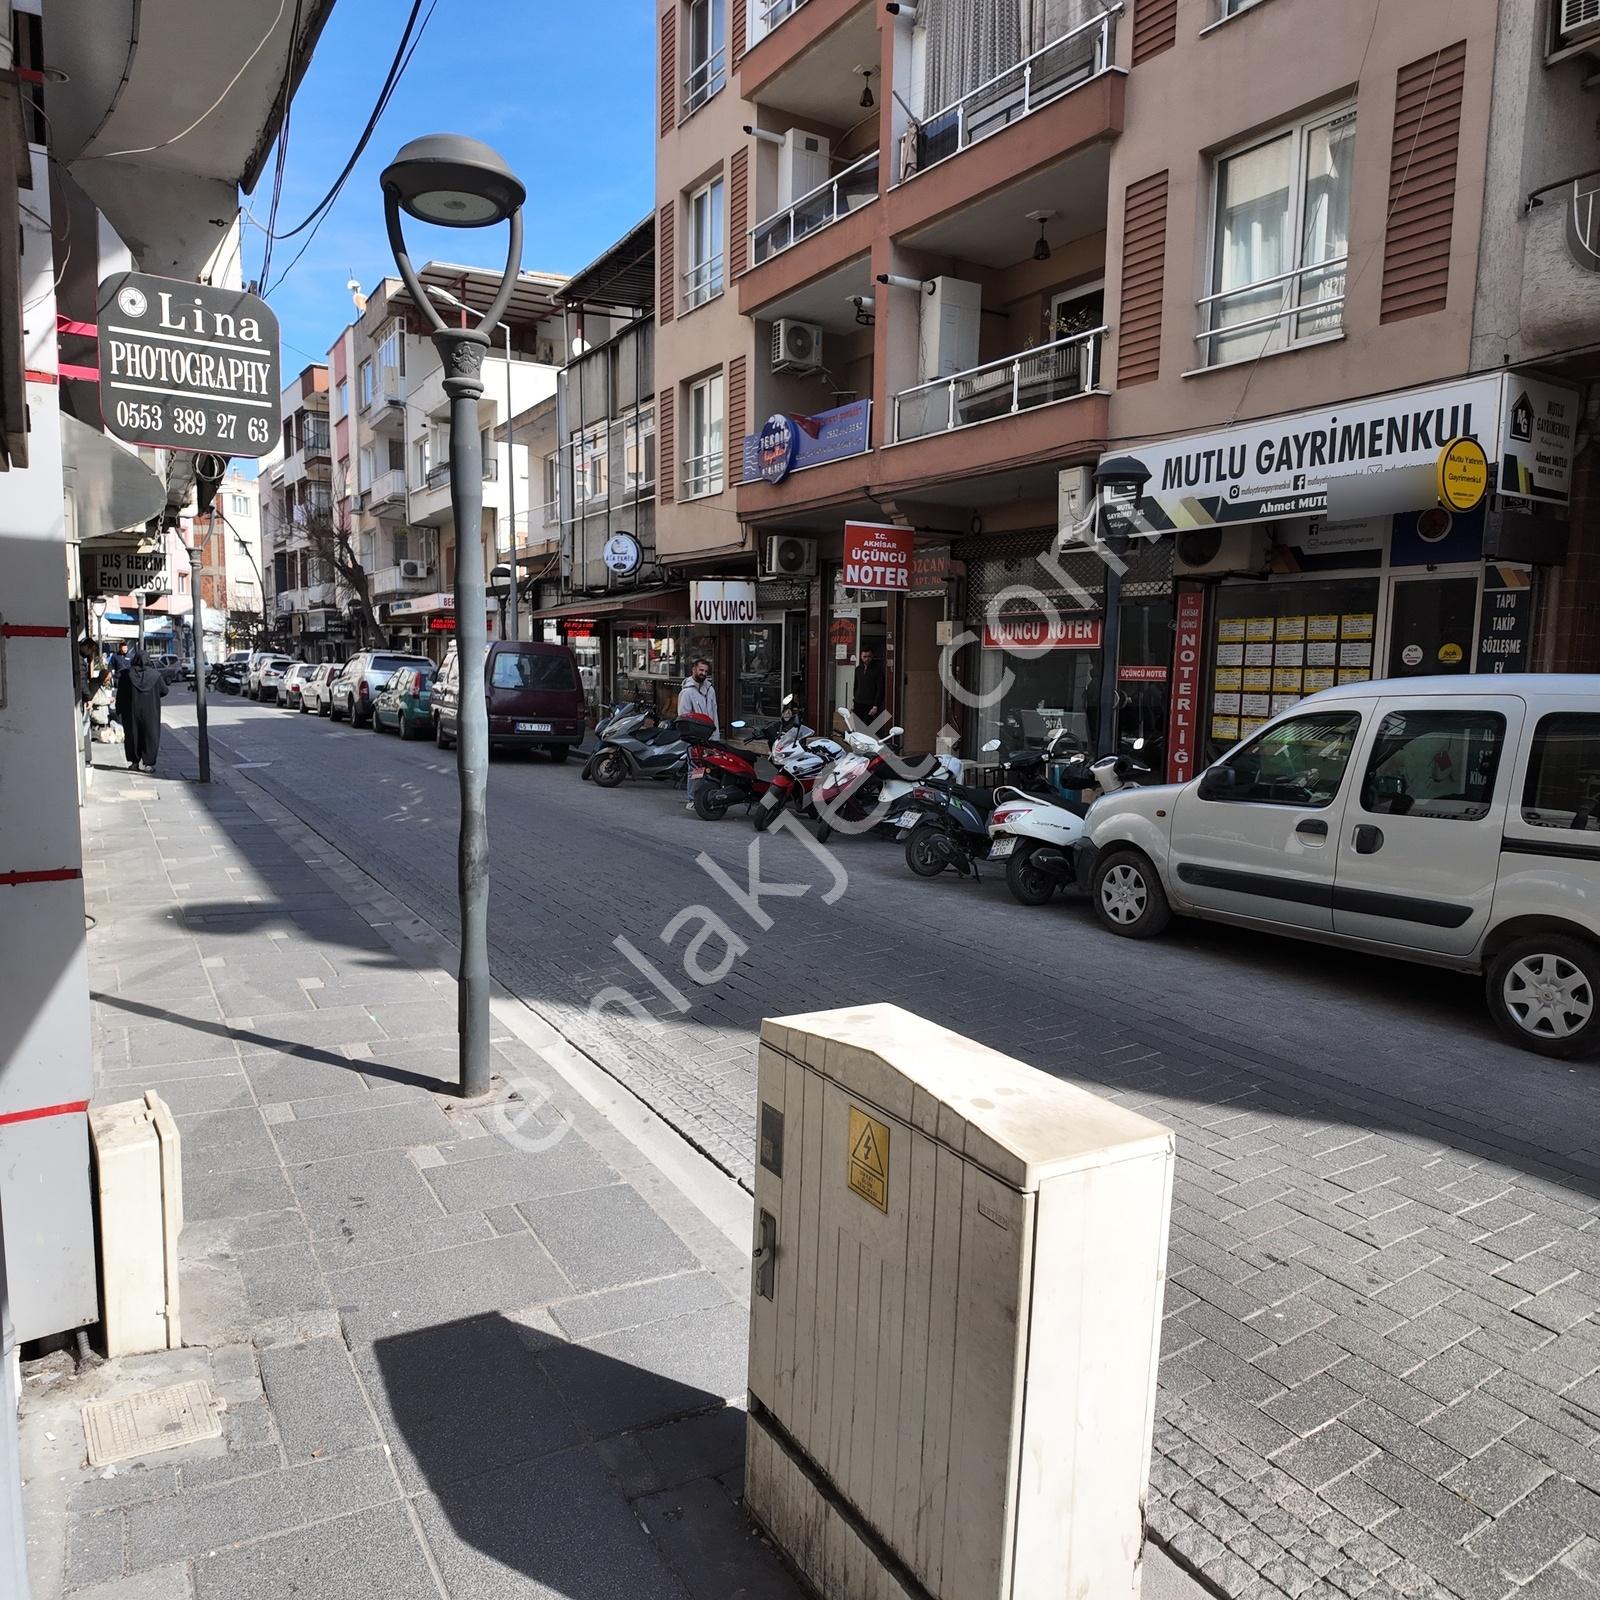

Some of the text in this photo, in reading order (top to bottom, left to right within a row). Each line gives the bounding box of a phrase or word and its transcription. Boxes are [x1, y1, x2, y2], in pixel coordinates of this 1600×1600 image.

[158, 291, 262, 343] Lina
[109, 340, 271, 396] PHOTOGRAPHY
[116, 400, 270, 443] 0553 389 27 63
[1161, 403, 1479, 491] MUTLU GAYRİMENKUL
[1259, 495, 1328, 514] Ahmet MUTL
[863, 540, 897, 549] AKHİSAR
[851, 547, 907, 564] ÜÇÜNCÜ
[100, 572, 169, 591] Erol ULUSOY
[846, 564, 908, 587] NOTER
[694, 600, 754, 621] KUYUMCU
[1496, 594, 1516, 609] TAPU
[1047, 620, 1093, 640] NOTER
[1492, 613, 1516, 631] TAKİP
[1482, 635, 1521, 658] SÖZLEŞME
[1121, 668, 1167, 680] ÜÇÜNCÜ NOTER
[1174, 633, 1196, 783] NOTERLİĞİ
